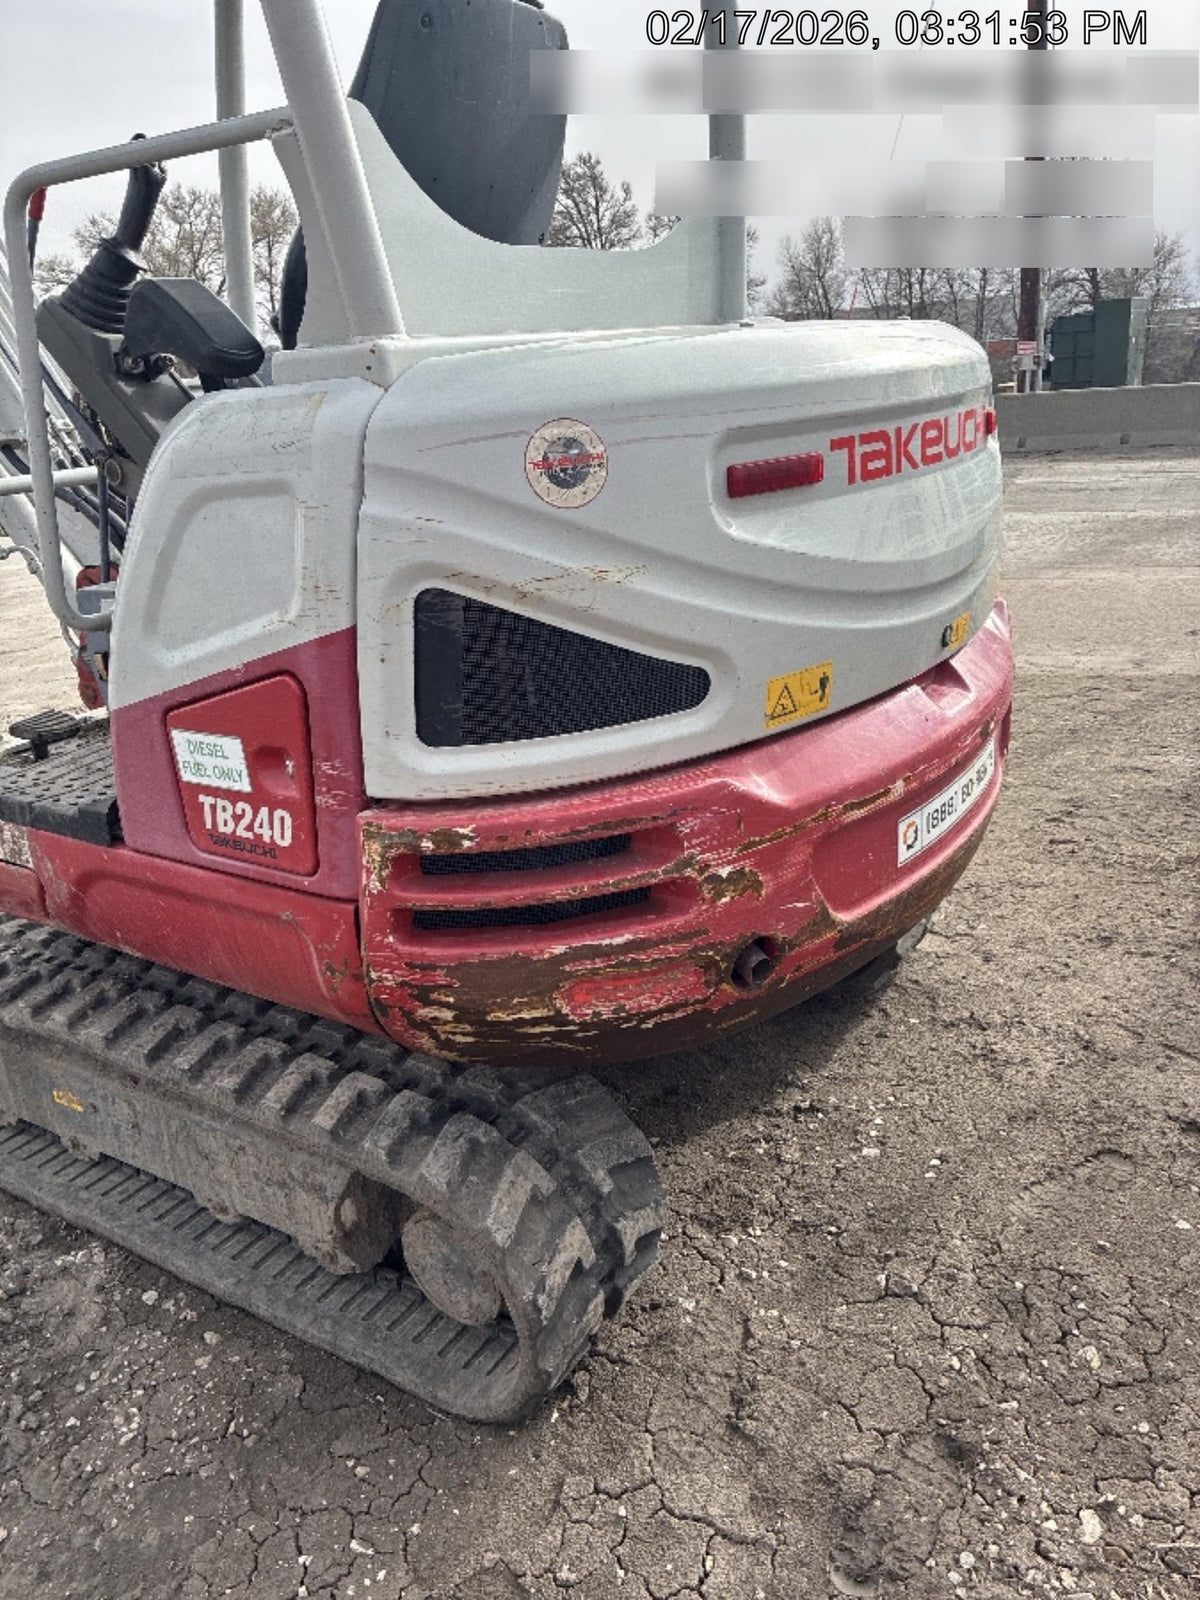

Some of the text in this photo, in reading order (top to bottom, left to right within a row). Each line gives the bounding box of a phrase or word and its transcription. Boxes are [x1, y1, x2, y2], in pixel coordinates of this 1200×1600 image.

[187, 738, 230, 760] DIESEL
[182, 760, 243, 784] FUEL ONLY
[198, 794, 292, 847] TB240
